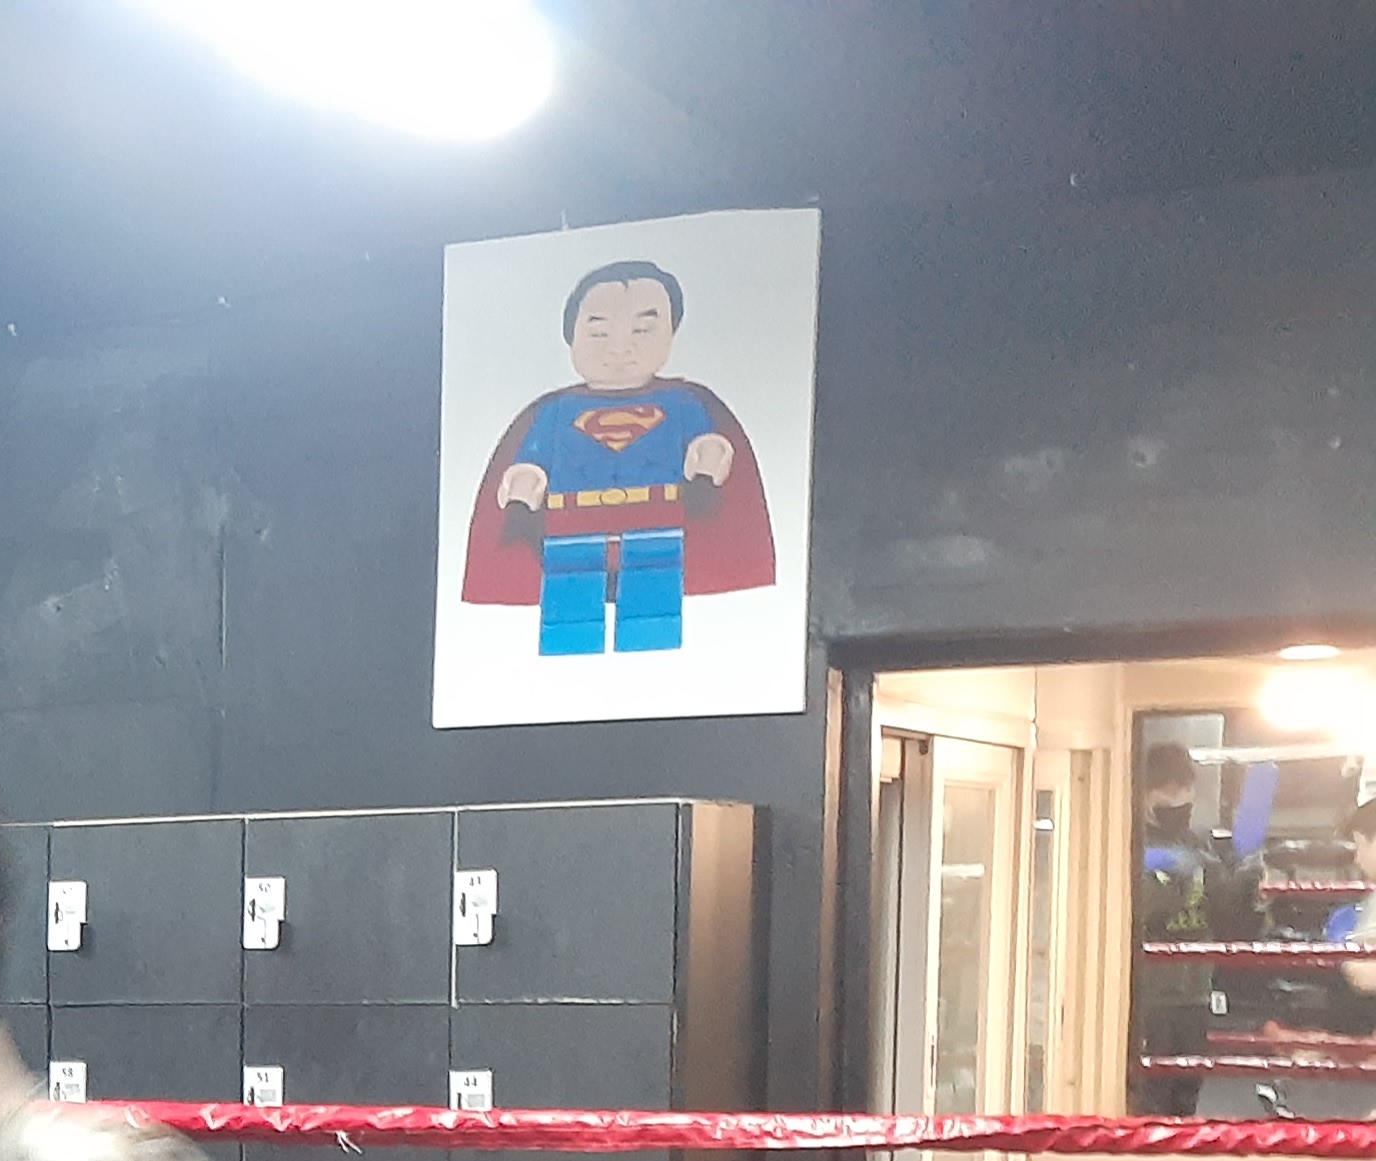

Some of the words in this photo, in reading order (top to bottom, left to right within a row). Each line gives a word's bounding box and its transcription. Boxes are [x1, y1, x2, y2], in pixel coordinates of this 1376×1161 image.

[62, 1067, 74, 1078] 58
[257, 1072, 269, 1083] 51
[463, 1076, 477, 1087] 44
